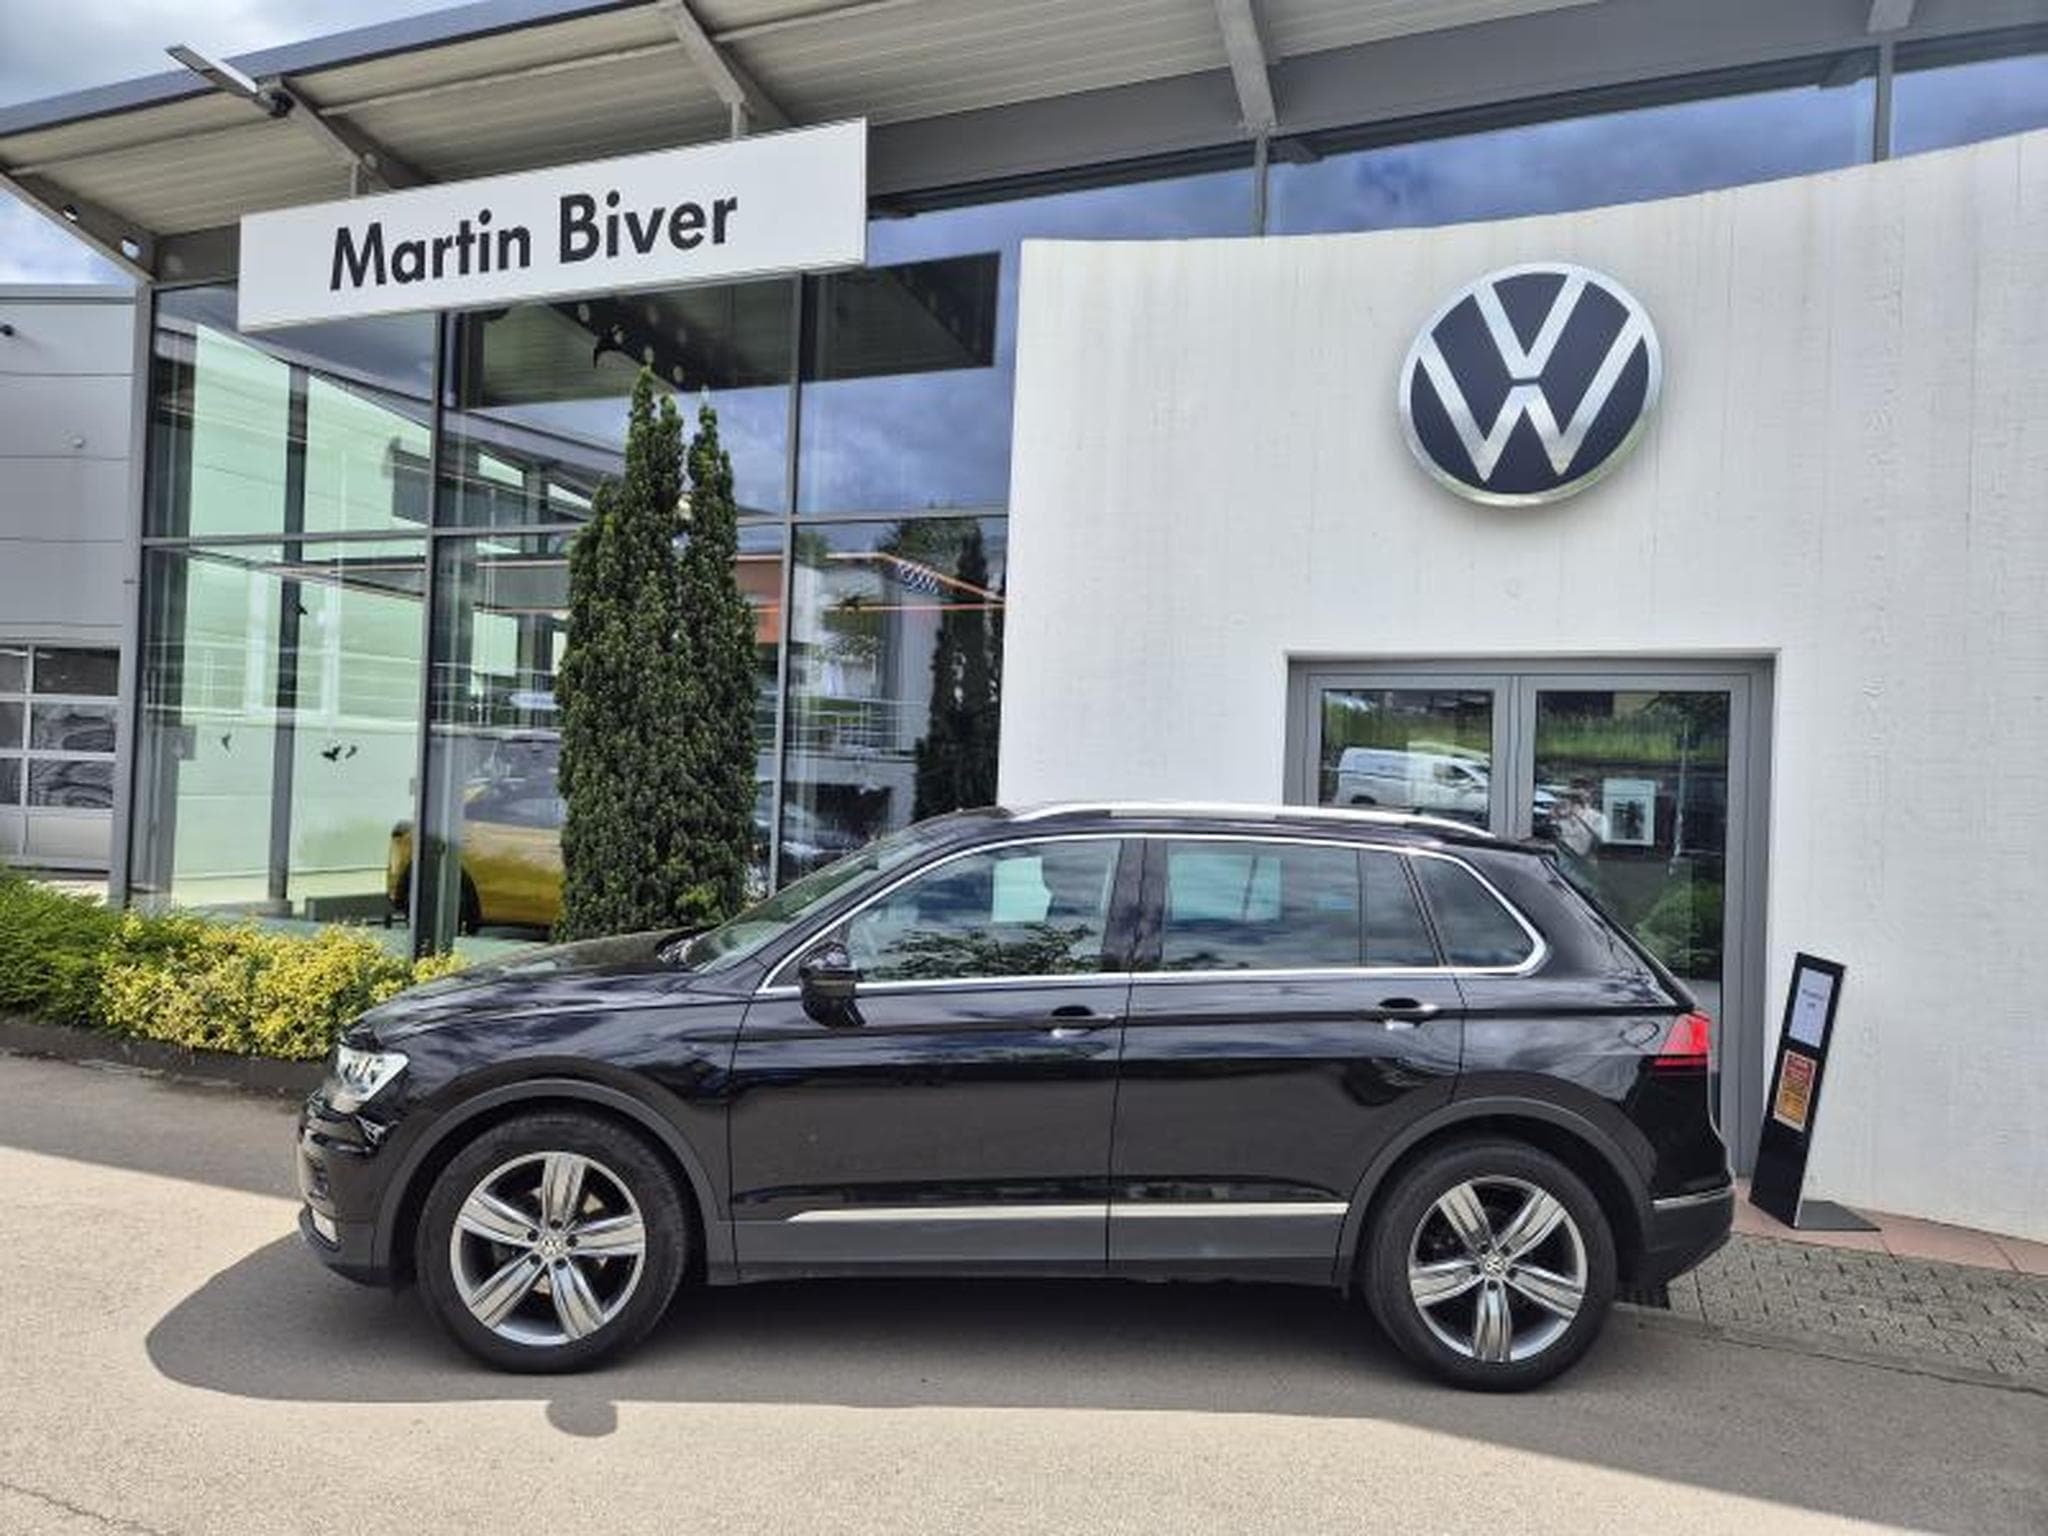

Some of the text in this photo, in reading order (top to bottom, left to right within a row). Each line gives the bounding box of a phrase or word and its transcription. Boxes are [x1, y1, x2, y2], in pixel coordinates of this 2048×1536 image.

[330, 190, 739, 291] Martin Biver
[1414, 265, 1647, 484] VW
